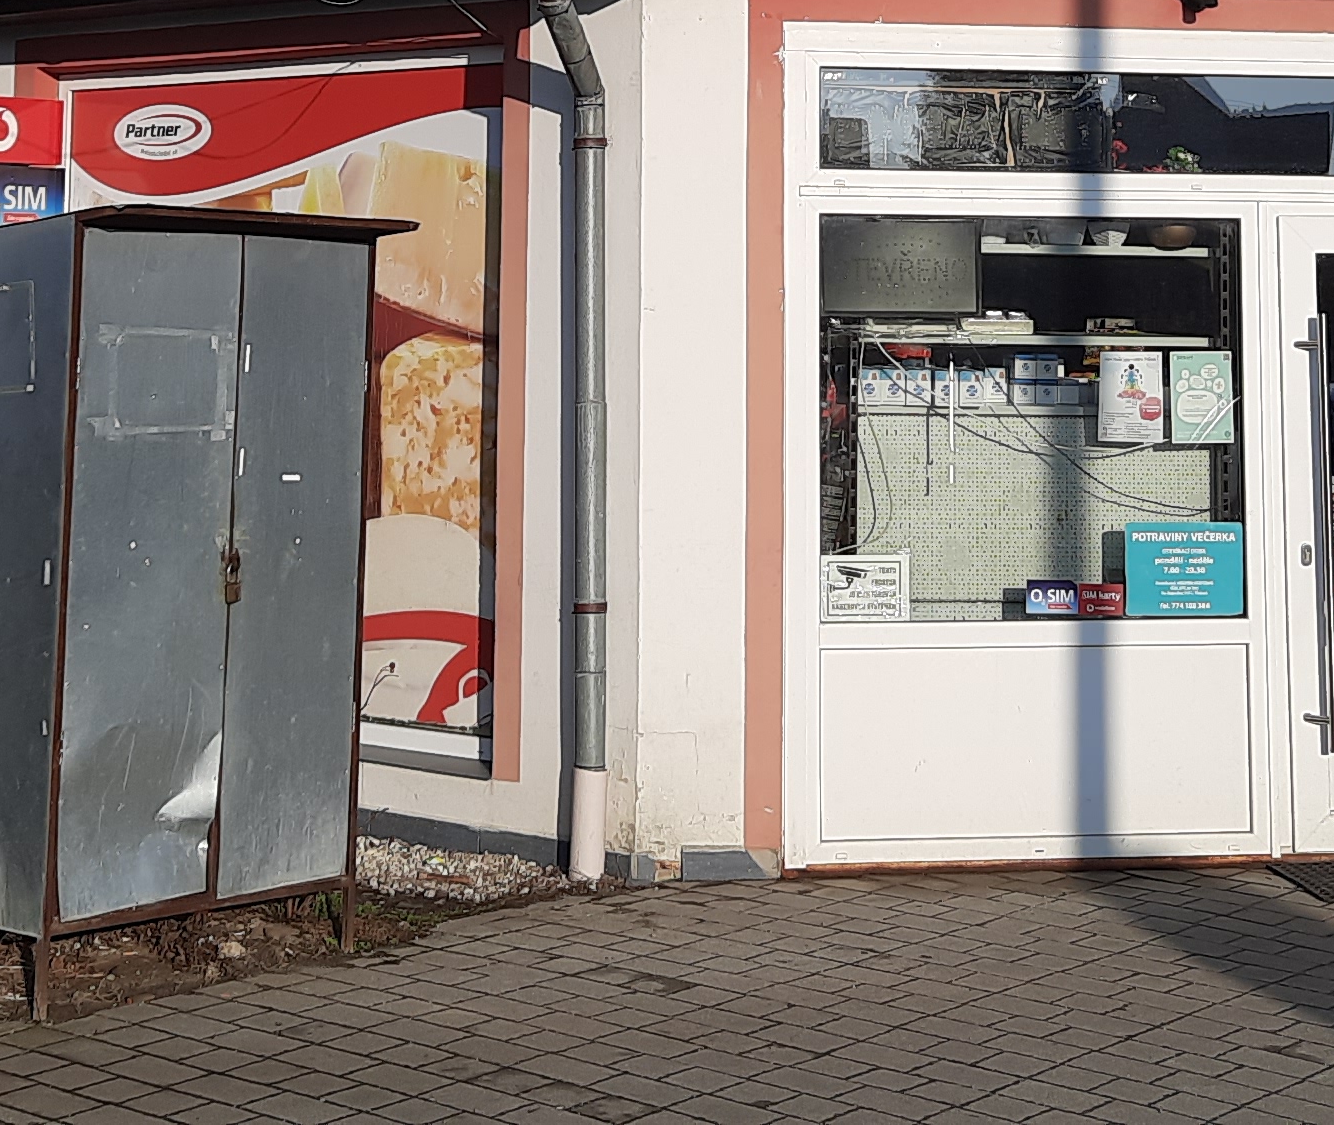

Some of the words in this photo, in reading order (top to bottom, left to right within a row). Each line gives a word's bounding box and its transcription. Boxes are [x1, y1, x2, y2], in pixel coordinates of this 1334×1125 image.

[124, 123, 182, 139] Partner
[3, 185, 47, 211] SIM
[839, 250, 968, 282] TEVŘENO
[1132, 532, 1188, 542] POTRAVINY
[1191, 530, 1236, 542] VEČERKA
[1047, 588, 1075, 603] SIM
[1082, 590, 1097, 600] SIM
[1099, 591, 1121, 602] karty
